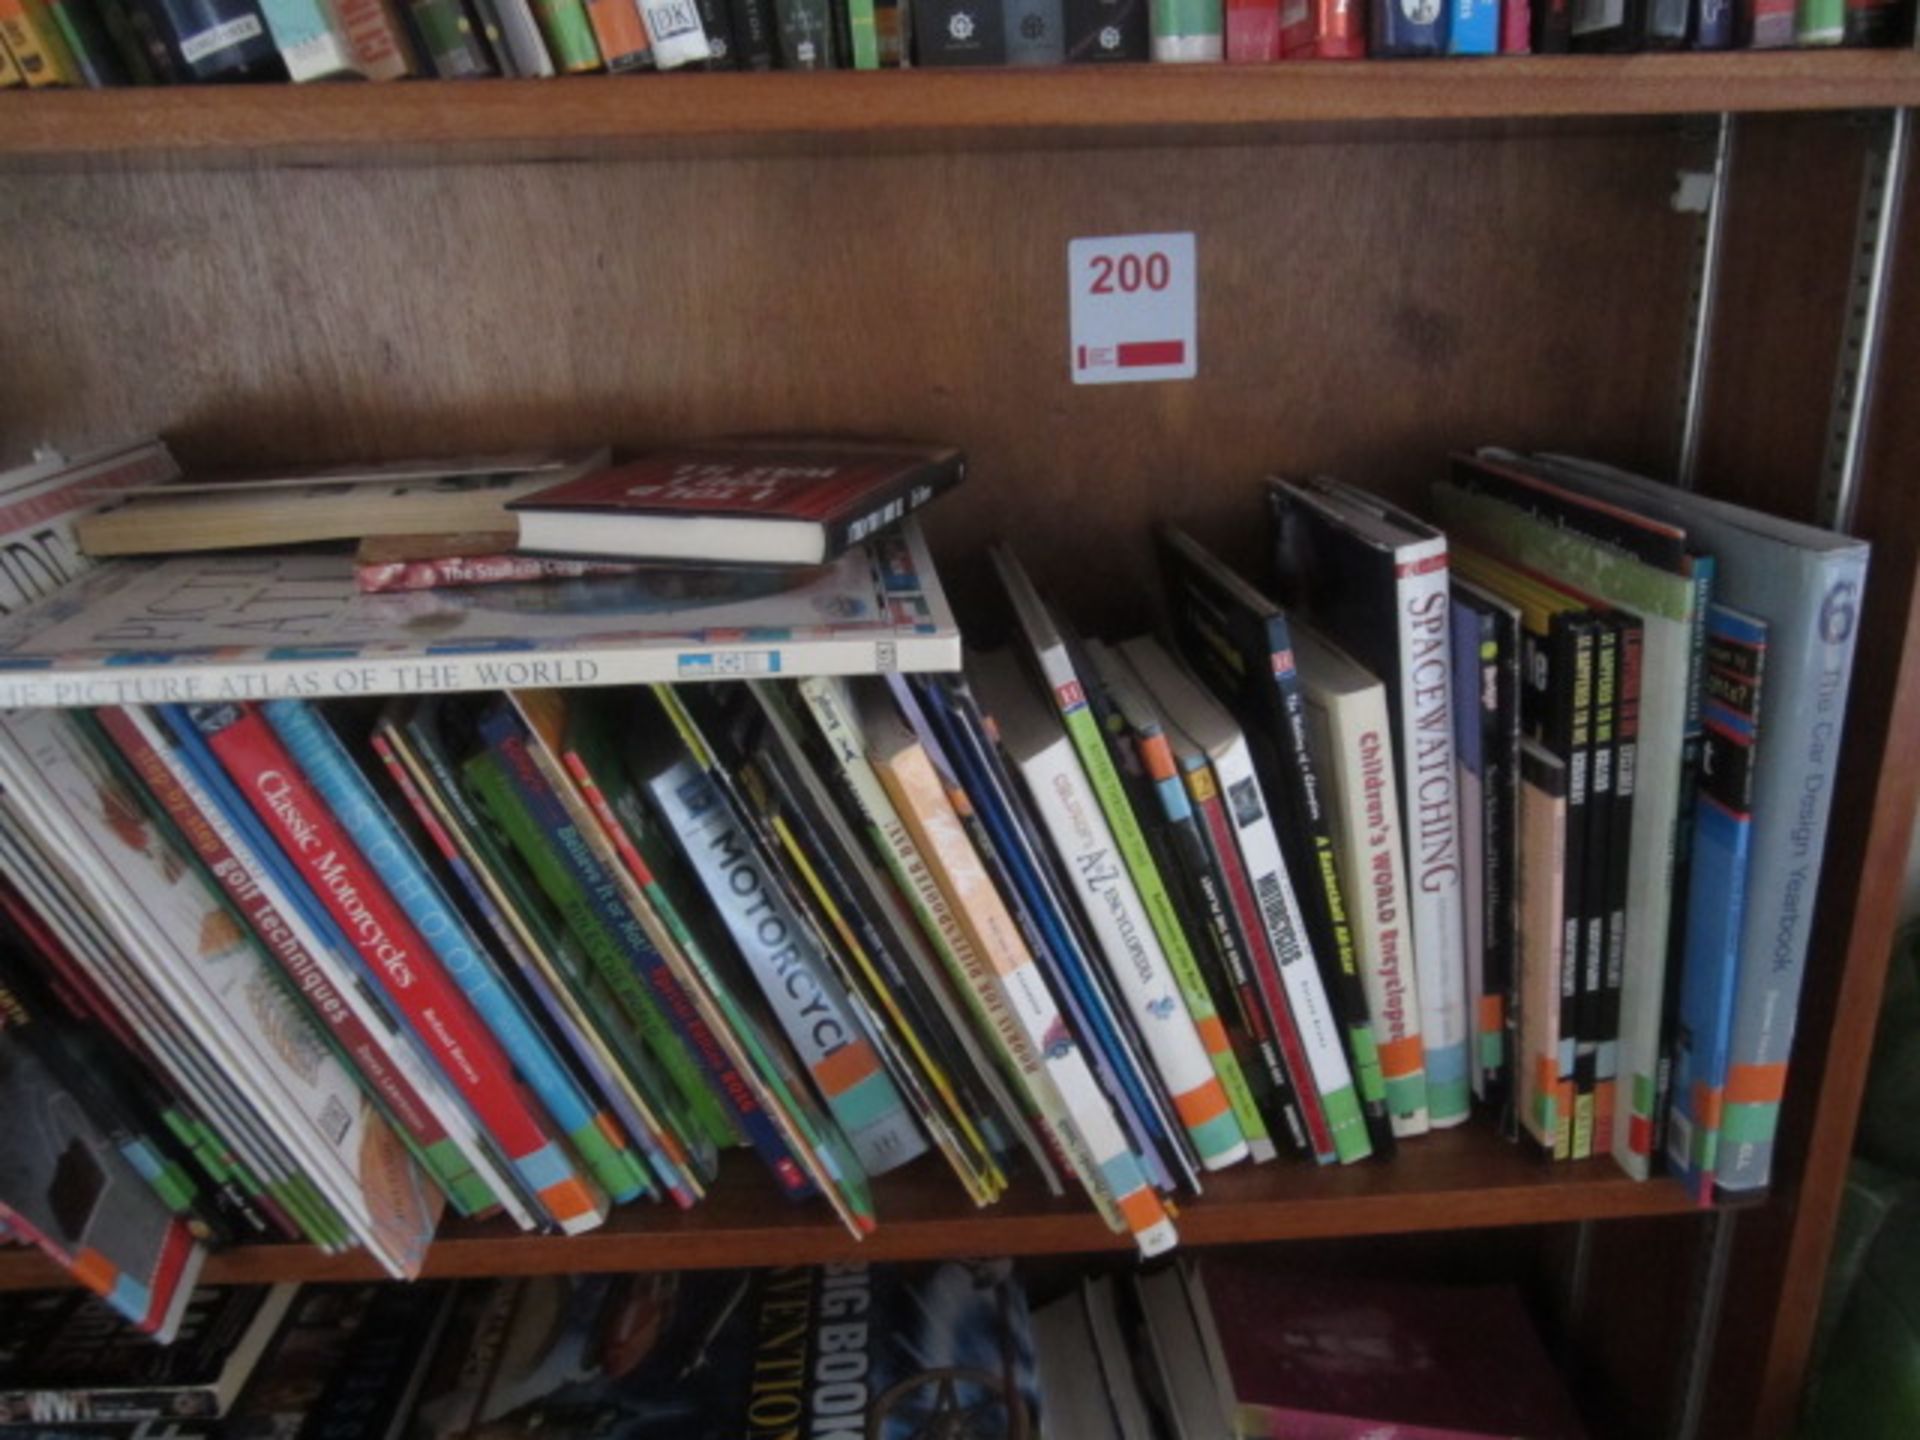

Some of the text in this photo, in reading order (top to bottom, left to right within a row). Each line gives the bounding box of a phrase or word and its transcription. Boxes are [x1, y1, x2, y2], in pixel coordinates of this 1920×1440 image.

[1088, 251, 1171, 294] 200
[1818, 578, 1855, 645] 6
[54, 674, 201, 703] PICTURE
[219, 668, 321, 698] ATLAS
[334, 667, 378, 693] OF
[391, 663, 460, 691] THE
[476, 659, 599, 687] WORLD
[1408, 590, 1461, 895] SPACEWATCHING
[1811, 713, 1835, 765] Car
[556, 825, 602, 885] Believe
[1358, 730, 1387, 848] Children's
[1373, 851, 1396, 930] WORLD
[1789, 771, 1824, 855] Design
[256, 768, 322, 852] Classic
[311, 848, 418, 992] Motorcycles
[1771, 856, 1809, 974] Yearbook
[211, 856, 262, 904] golf
[253, 904, 349, 1024] techniques
